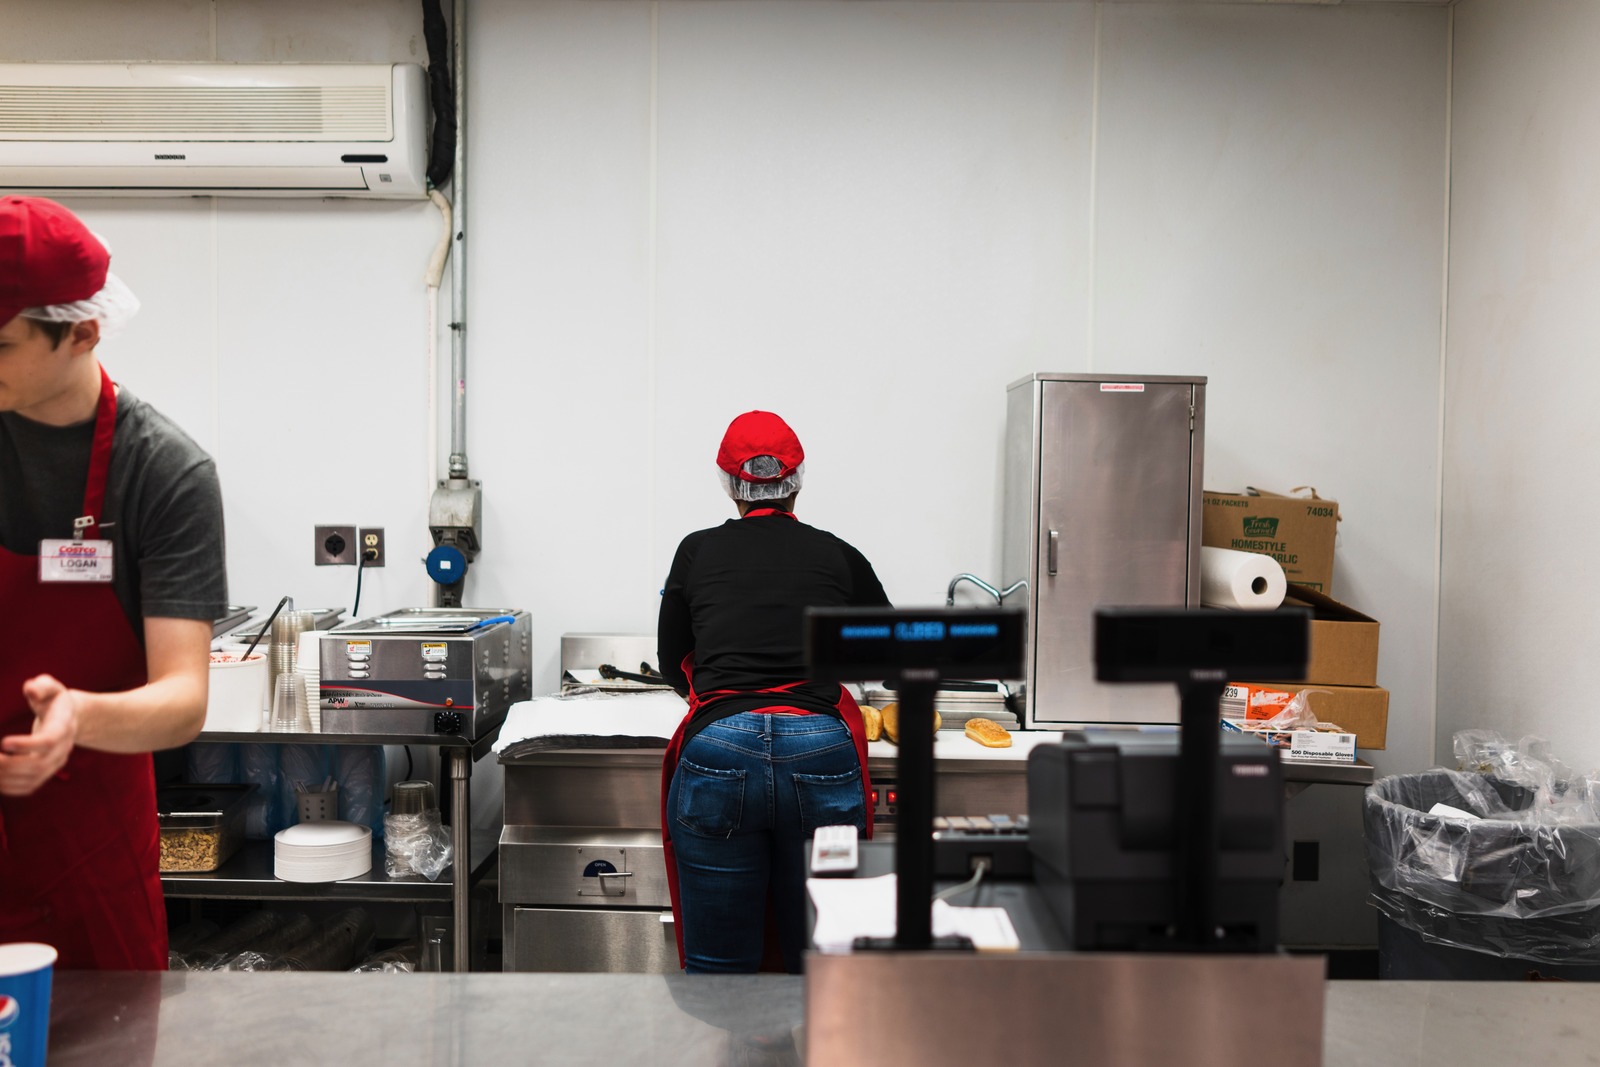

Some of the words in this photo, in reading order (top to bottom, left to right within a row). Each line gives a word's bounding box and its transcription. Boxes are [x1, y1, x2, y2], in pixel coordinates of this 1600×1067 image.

[1221, 499, 1248, 508] PACKETS
[1307, 506, 1334, 517] 74034
[1231, 538, 1286, 552] HOMESTYLE
[61, 559, 97, 567] LOGAN
[1225, 687, 1238, 698] 239
